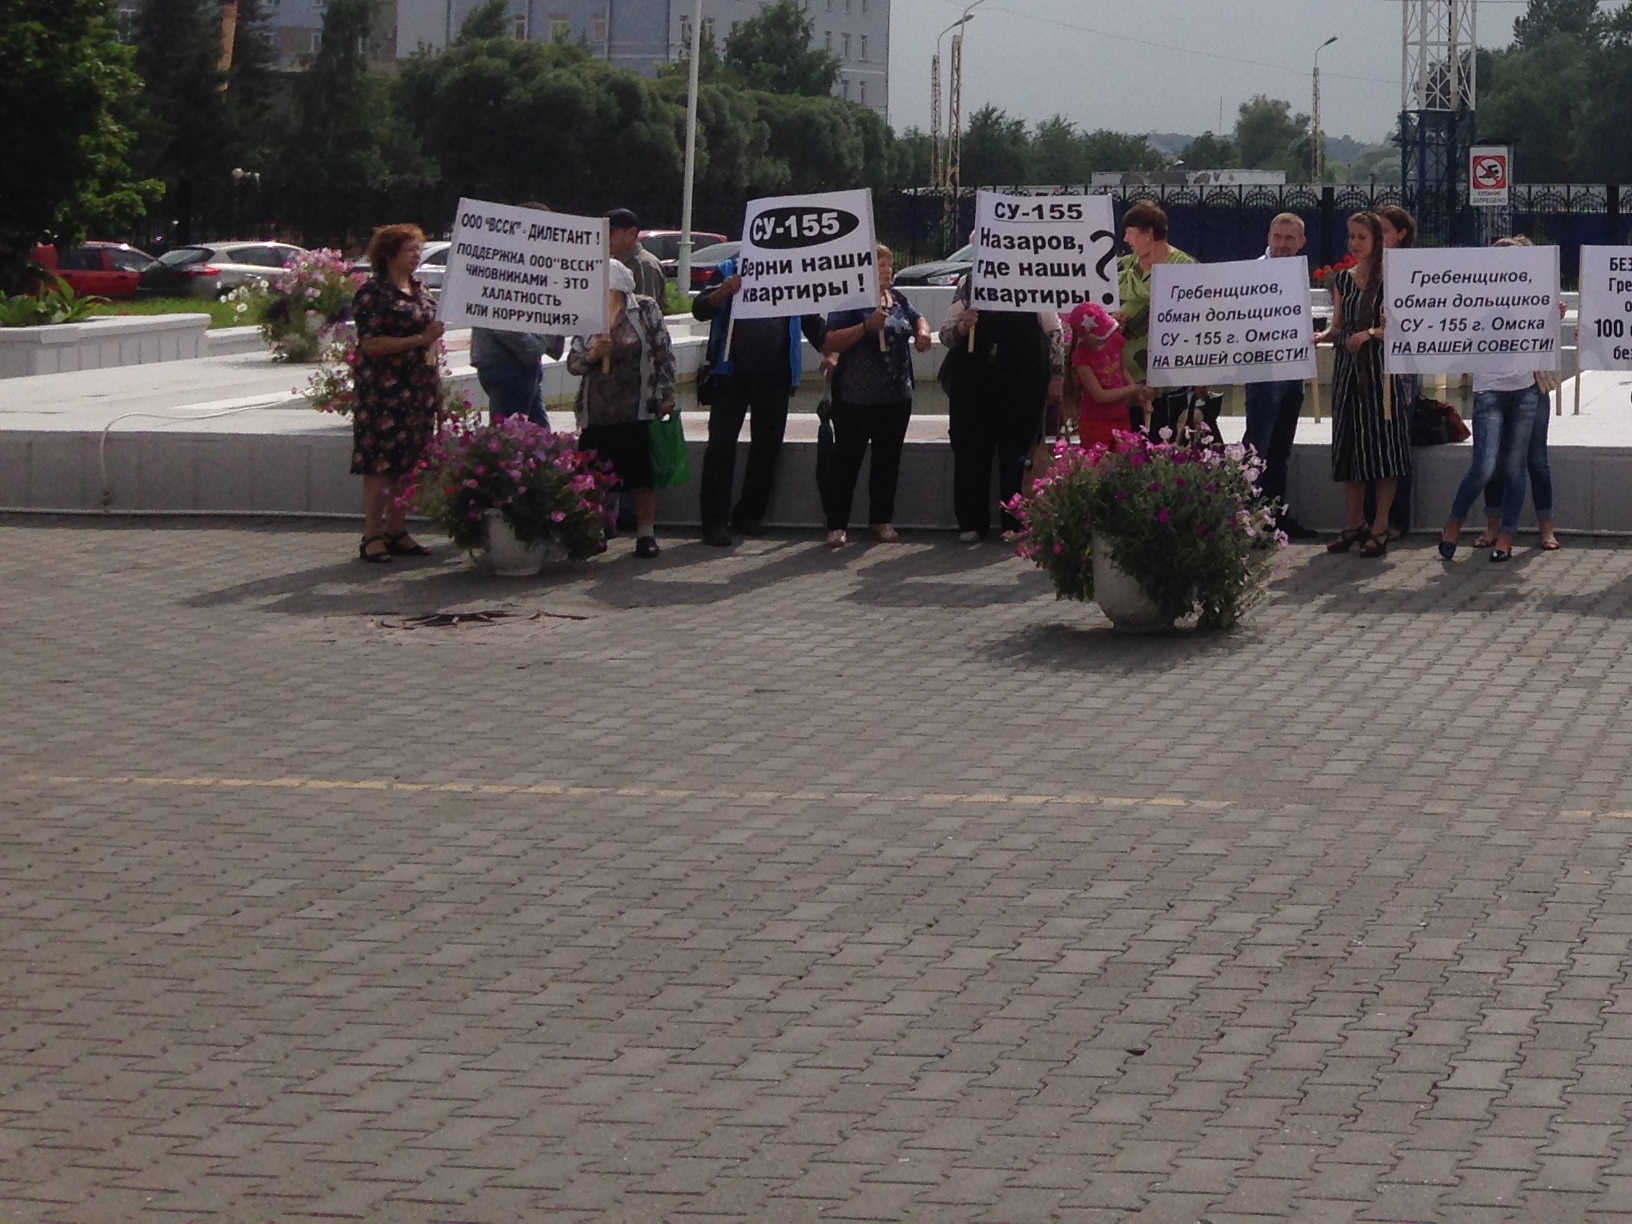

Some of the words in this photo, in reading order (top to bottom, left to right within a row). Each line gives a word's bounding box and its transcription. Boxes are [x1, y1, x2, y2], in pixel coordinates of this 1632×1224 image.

[994, 202, 1083, 220] СУ-155
[462, 213, 482, 229] ООО
[528, 224, 592, 245] ДИЛЕТАНТ
[596, 231, 600, 245] !
[753, 212, 840, 240] СУ-155
[981, 227, 1084, 254] Назаров,
[457, 243, 525, 265] ПОДДЕРЖКА
[741, 258, 792, 281] Верни
[802, 251, 872, 272] наши
[978, 260, 1010, 279] где
[1019, 262, 1086, 276] наши
[466, 263, 547, 287] ЧИНОВНИКАМИ
[564, 278, 588, 289] ЭТО
[1411, 270, 1532, 287] Гребенщиков,
[482, 286, 561, 306] ХАЛАТНОСТЬ
[743, 280, 848, 305] квартиры
[857, 274, 865, 292] !
[974, 287, 1090, 308] квартиры
[1171, 283, 1283, 302] Гребенщиков,
[1394, 295, 1446, 308] обман
[1452, 294, 1550, 309] дольщиков
[466, 303, 488, 317] ИЛИ
[493, 307, 578, 326] КОРРУПЦИЯ?
[1158, 309, 1200, 323] обман
[1206, 305, 1301, 321] дольщиков
[1401, 319, 1423, 332] СУ
[1440, 318, 1467, 331] 155
[1492, 317, 1545, 330] Омска
[1594, 319, 1623, 338] 100
[1161, 333, 1179, 346] СУ
[1195, 332, 1221, 345] 155
[1245, 329, 1298, 342] Омска
[1391, 341, 1412, 354] НА
[1417, 338, 1472, 353] ВАШЕЙ
[1477, 339, 1554, 353] СОВЕСТИ!
[1153, 356, 1169, 367] НА
[1175, 351, 1227, 366] ВАШЕЙ
[1233, 348, 1308, 364] СОВЕСТИ!
